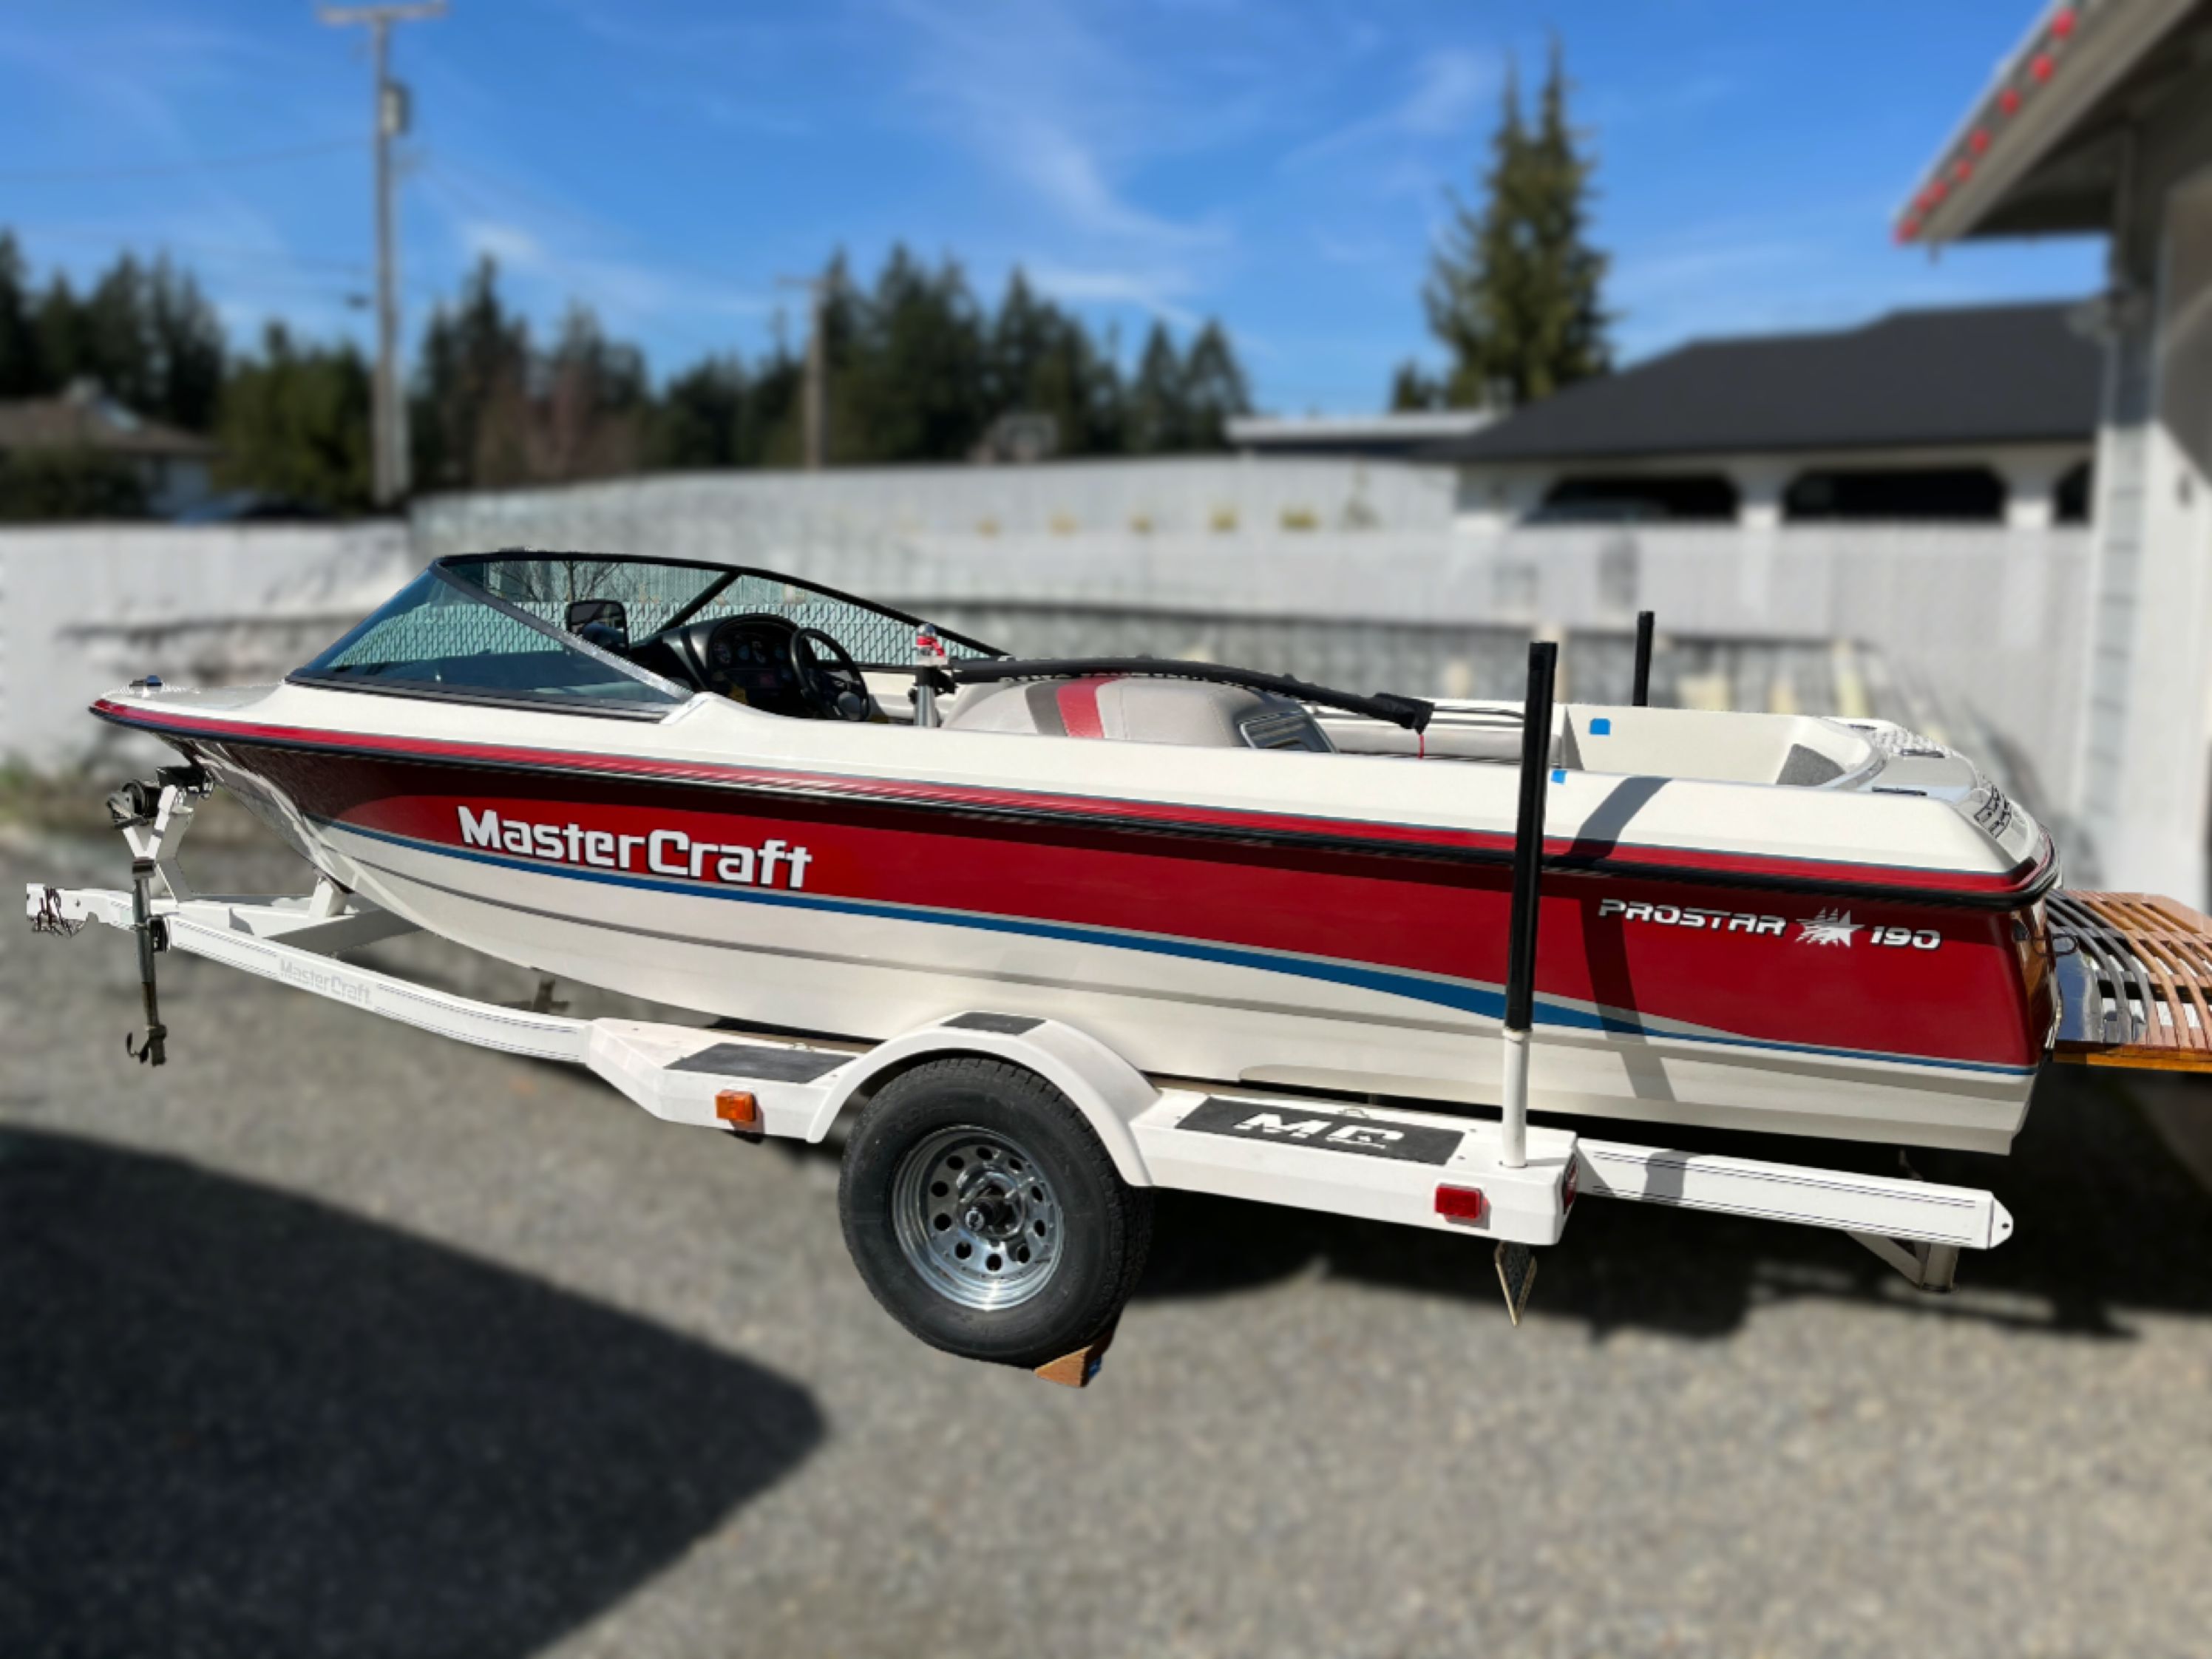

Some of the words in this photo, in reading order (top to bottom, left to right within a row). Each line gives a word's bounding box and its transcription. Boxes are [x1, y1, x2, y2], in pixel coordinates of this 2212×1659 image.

[458, 806, 812, 888] MasterCraft
[1598, 898, 1787, 937] PROSTAR
[1870, 926, 1941, 950] 190
[280, 958, 373, 1005] MasterCraft
